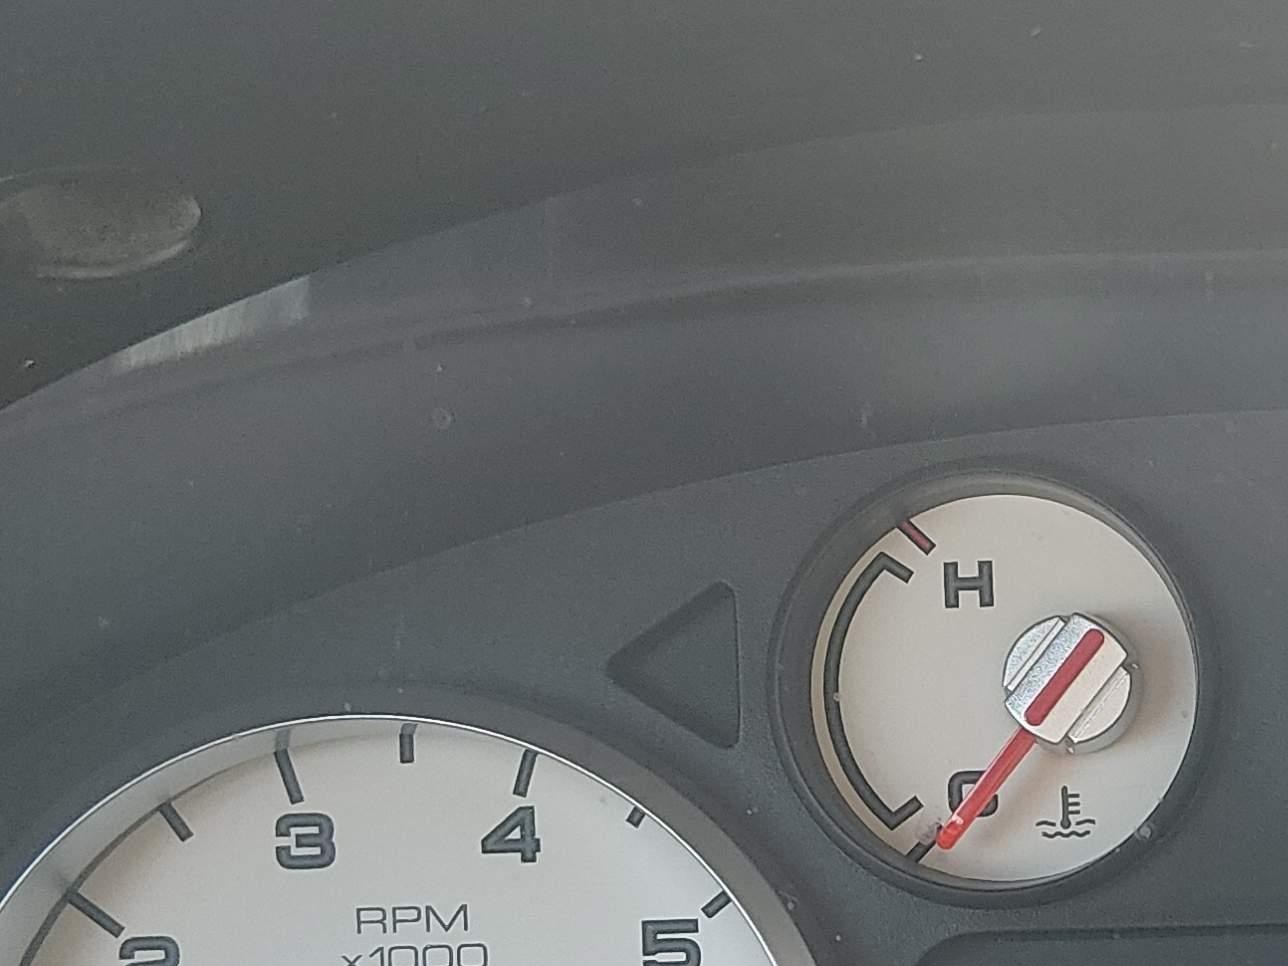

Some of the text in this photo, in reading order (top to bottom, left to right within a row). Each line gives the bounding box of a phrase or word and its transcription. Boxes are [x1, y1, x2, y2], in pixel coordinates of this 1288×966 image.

[943, 561, 994, 607] H
[275, 812, 337, 870] 3
[480, 806, 541, 863] 4
[356, 904, 469, 934] RPM
